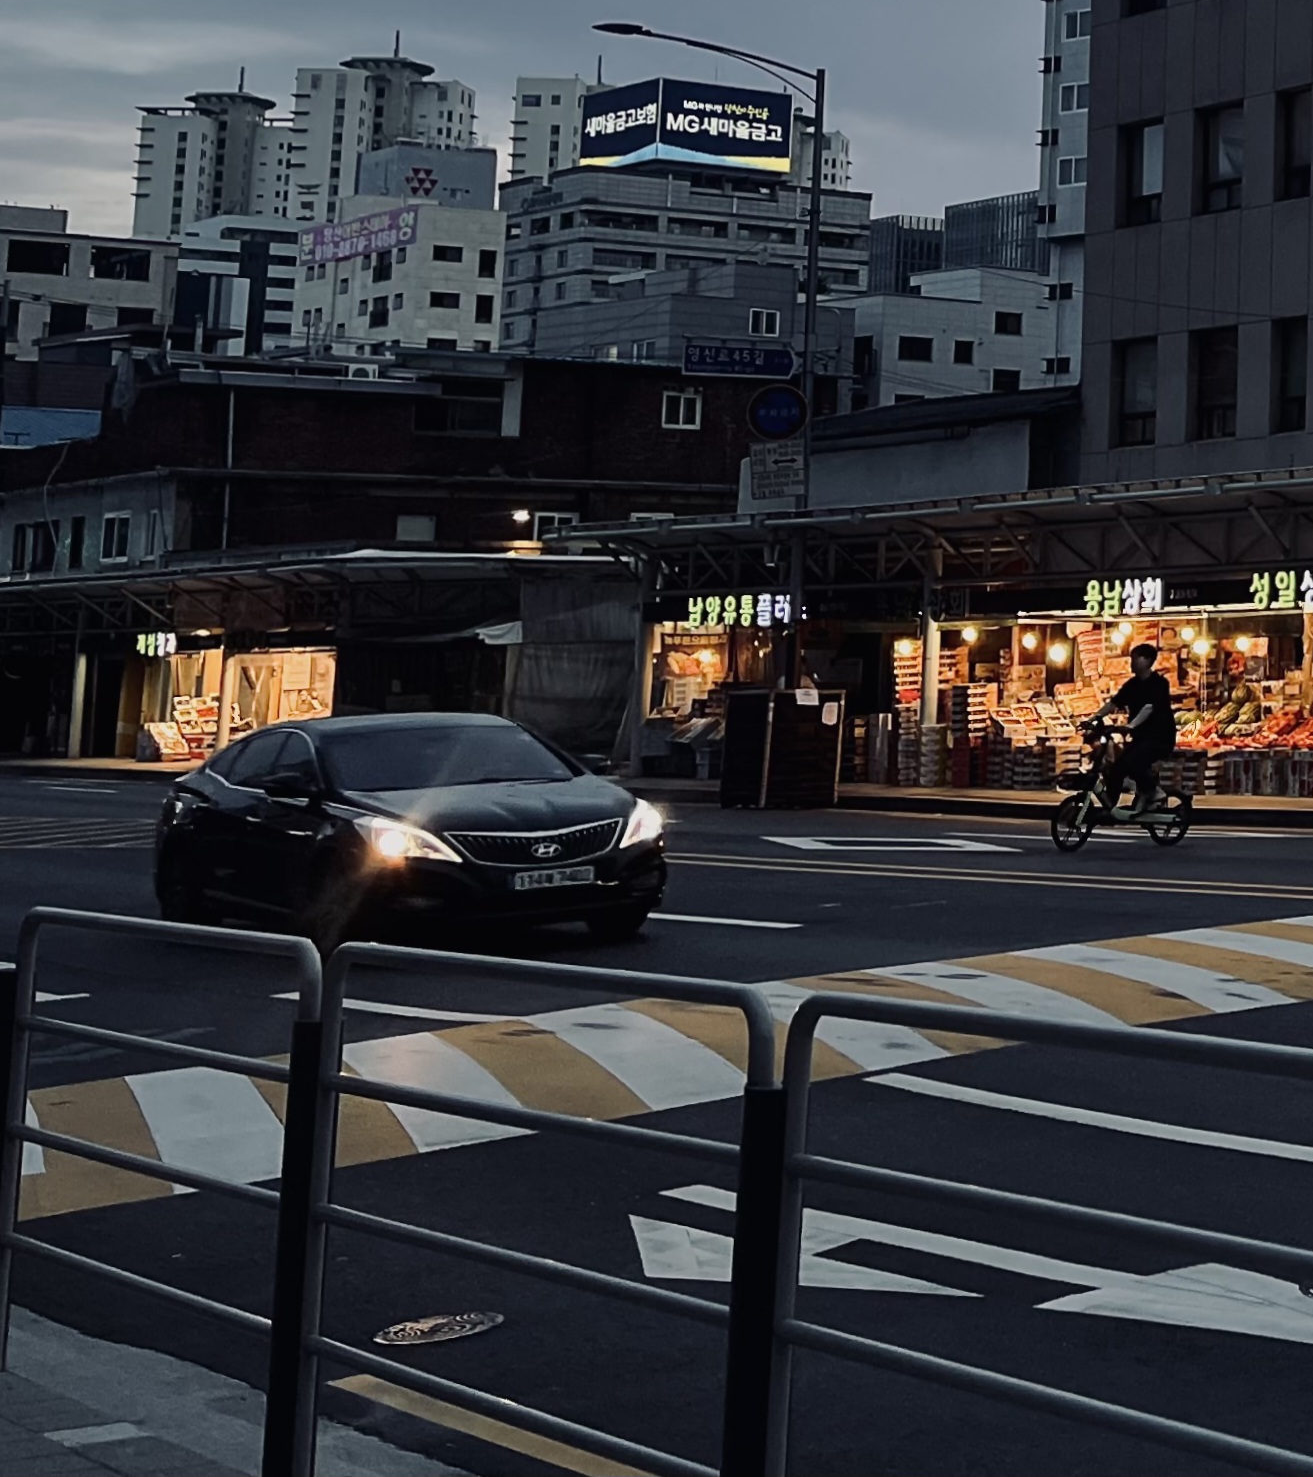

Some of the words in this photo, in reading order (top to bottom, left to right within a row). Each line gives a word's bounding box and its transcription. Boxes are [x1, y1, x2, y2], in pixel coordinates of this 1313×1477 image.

[584, 102, 658, 138] 새마을금고보험
[399, 211, 415, 241] 양
[687, 347, 765, 366] 영신로45길
[1083, 577, 1163, 617] 용남상회
